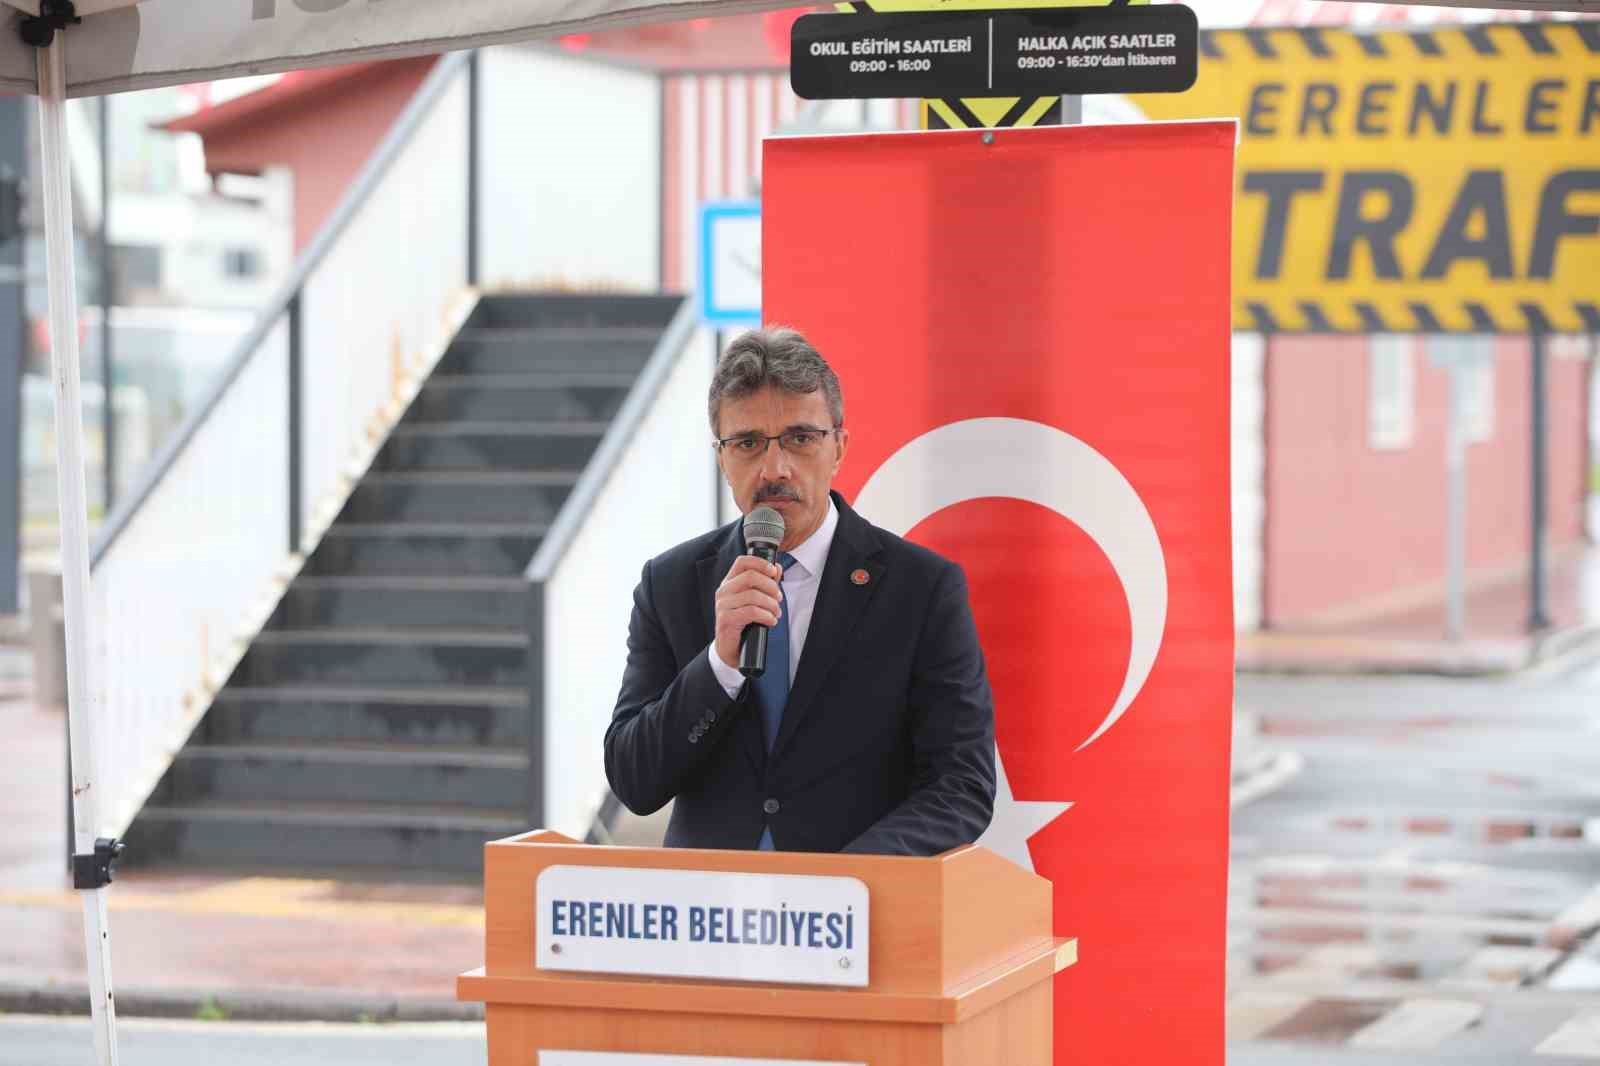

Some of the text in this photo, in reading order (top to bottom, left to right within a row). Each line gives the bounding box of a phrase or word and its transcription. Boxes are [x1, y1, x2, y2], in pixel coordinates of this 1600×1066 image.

[810, 36, 972, 56] OKUL EĞİTİM SAATLERİ
[1018, 34, 1176, 51] HALKA AÇIK SAATLER
[850, 60, 887, 72] 09:00
[897, 59, 931, 71] 16:00
[1017, 56, 1055, 69] 09:00
[1066, 55, 1125, 67] 16:30'dan
[1127, 52, 1176, 66] İtibaren
[1242, 169, 1600, 280] TRAF
[551, 899, 854, 949] ERENLER BELEDİYESİ
